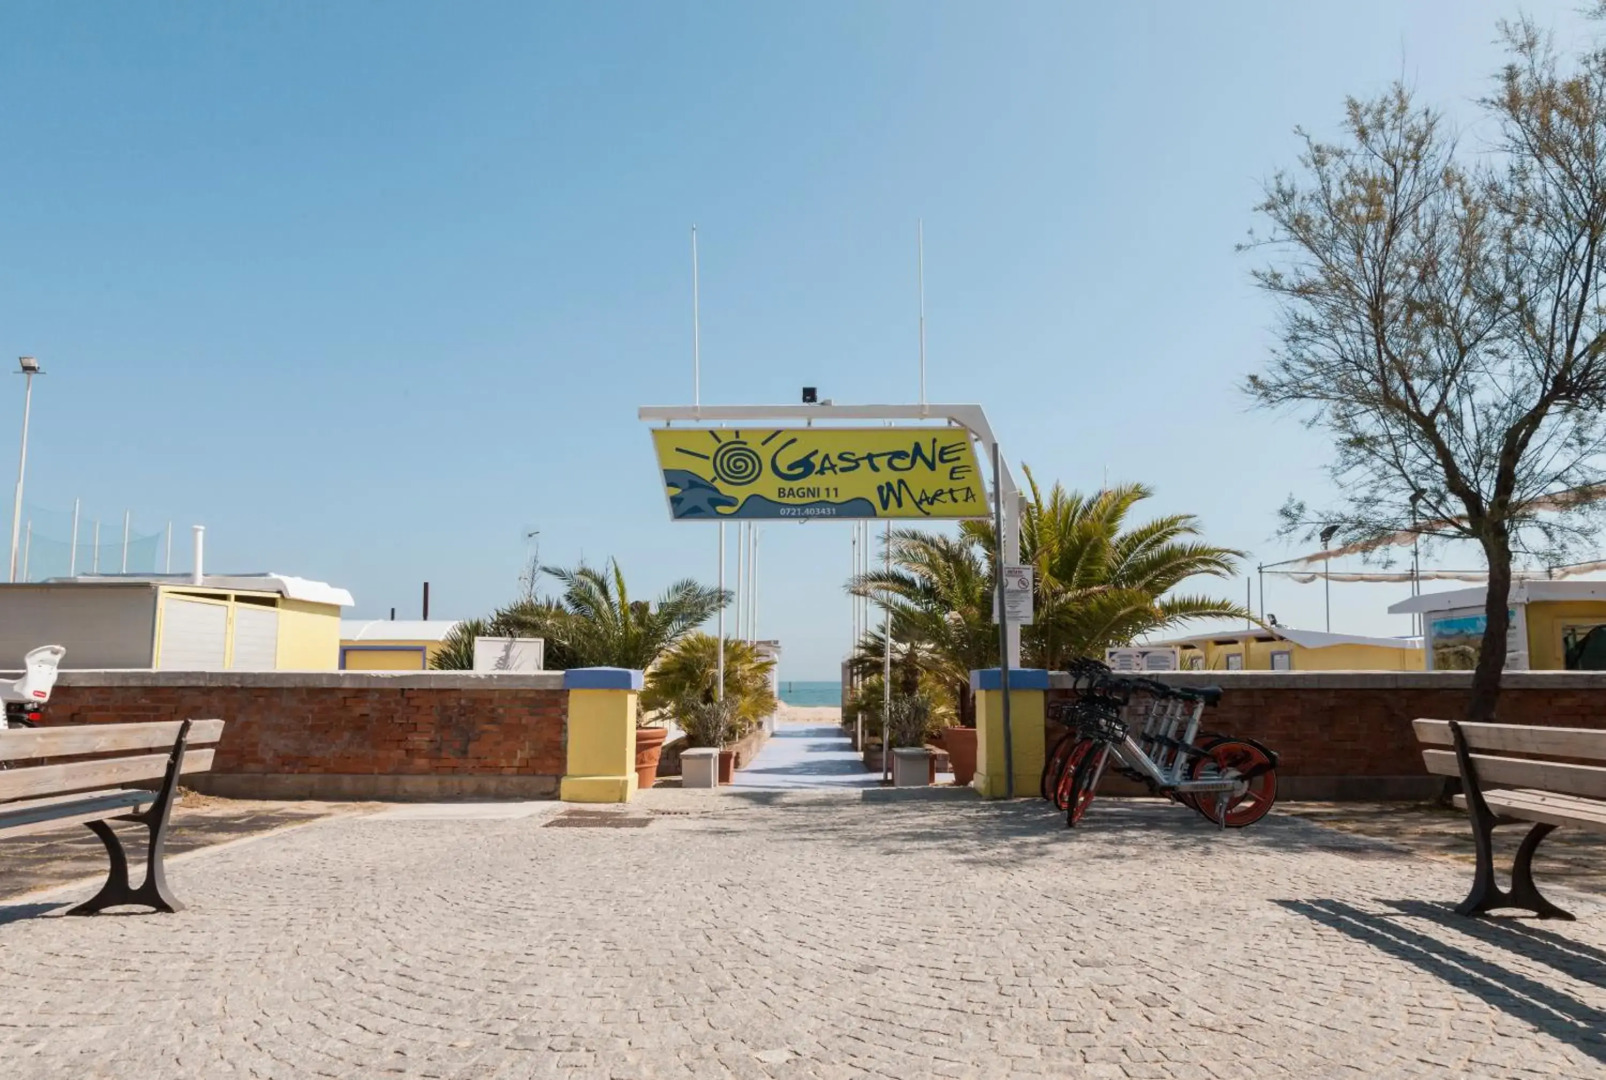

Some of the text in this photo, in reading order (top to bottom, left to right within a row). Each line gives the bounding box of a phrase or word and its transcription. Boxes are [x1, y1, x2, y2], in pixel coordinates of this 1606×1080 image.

[771, 437, 966, 481] GASTONE
[949, 465, 972, 480] E
[778, 487, 839, 499] BAGNI 11
[876, 478, 977, 515] MARTA
[779, 506, 837, 517] 0721.403431
